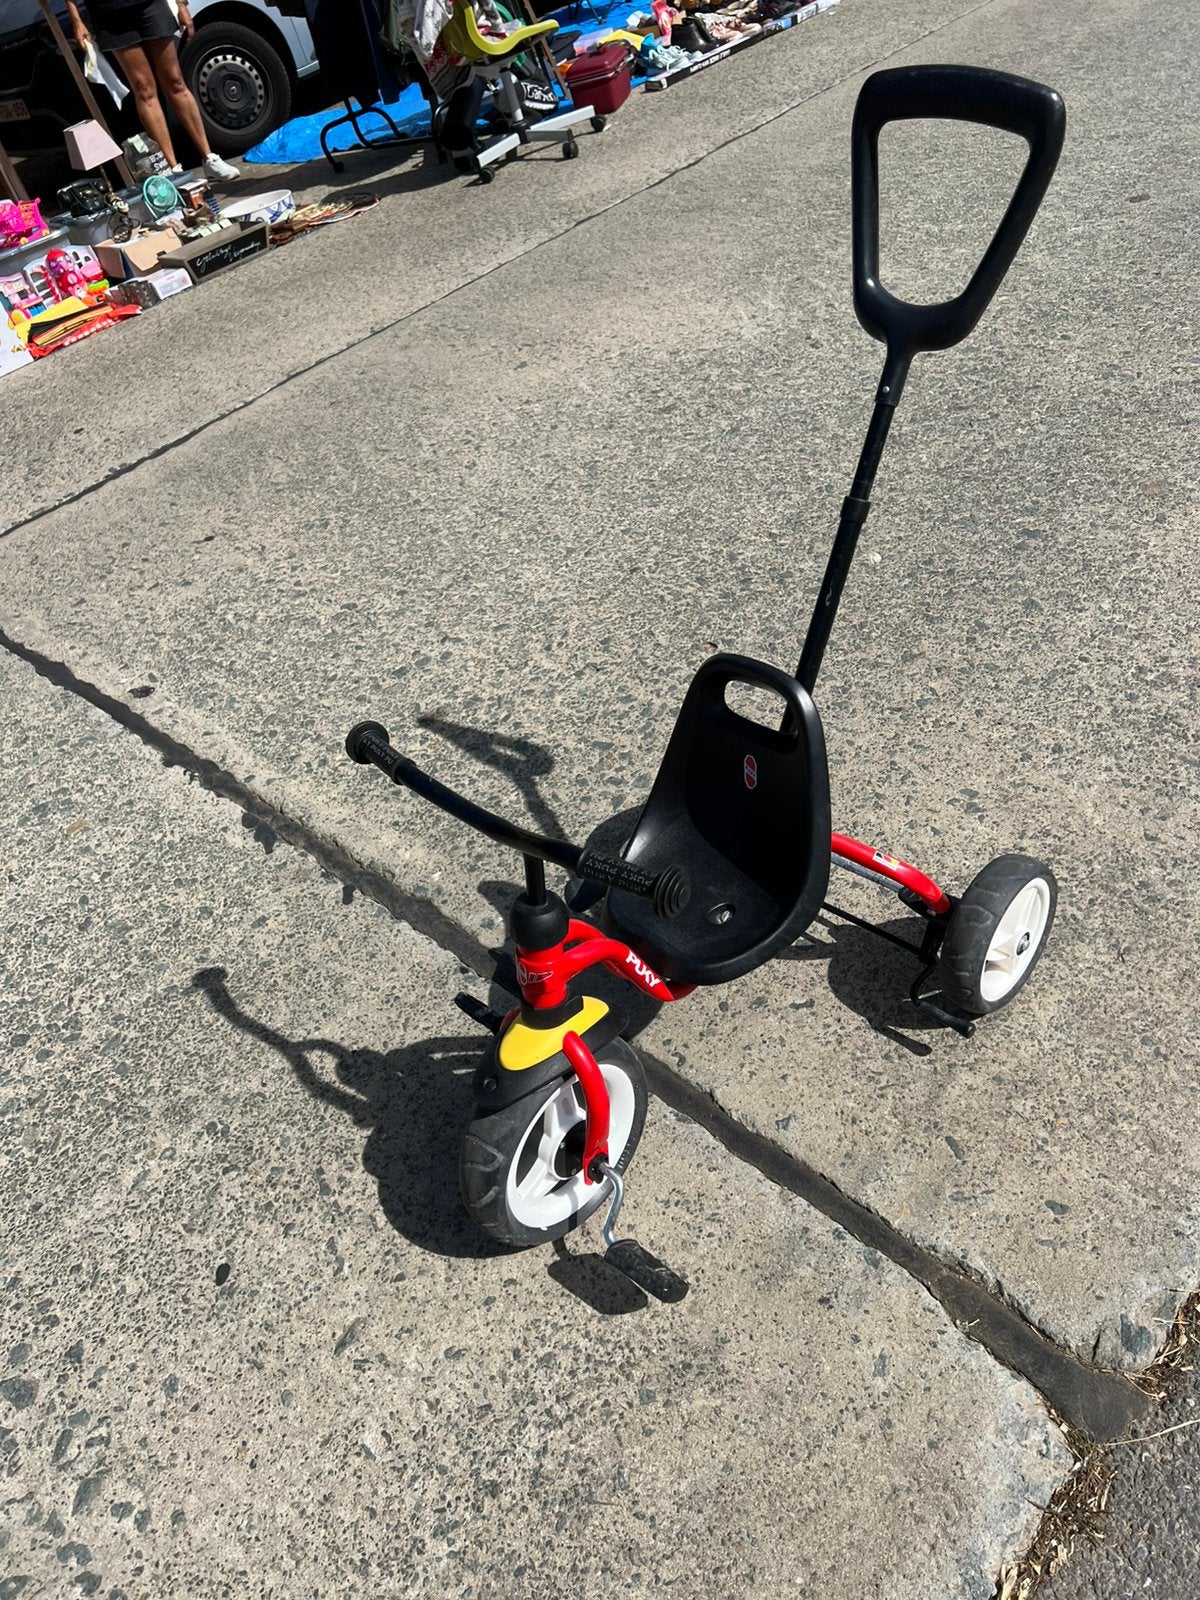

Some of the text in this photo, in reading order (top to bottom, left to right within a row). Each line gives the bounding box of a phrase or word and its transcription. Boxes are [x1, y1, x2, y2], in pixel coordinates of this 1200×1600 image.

[586, 858, 654, 887] PUKY PUKY
[626, 950, 660, 987] PUKY
